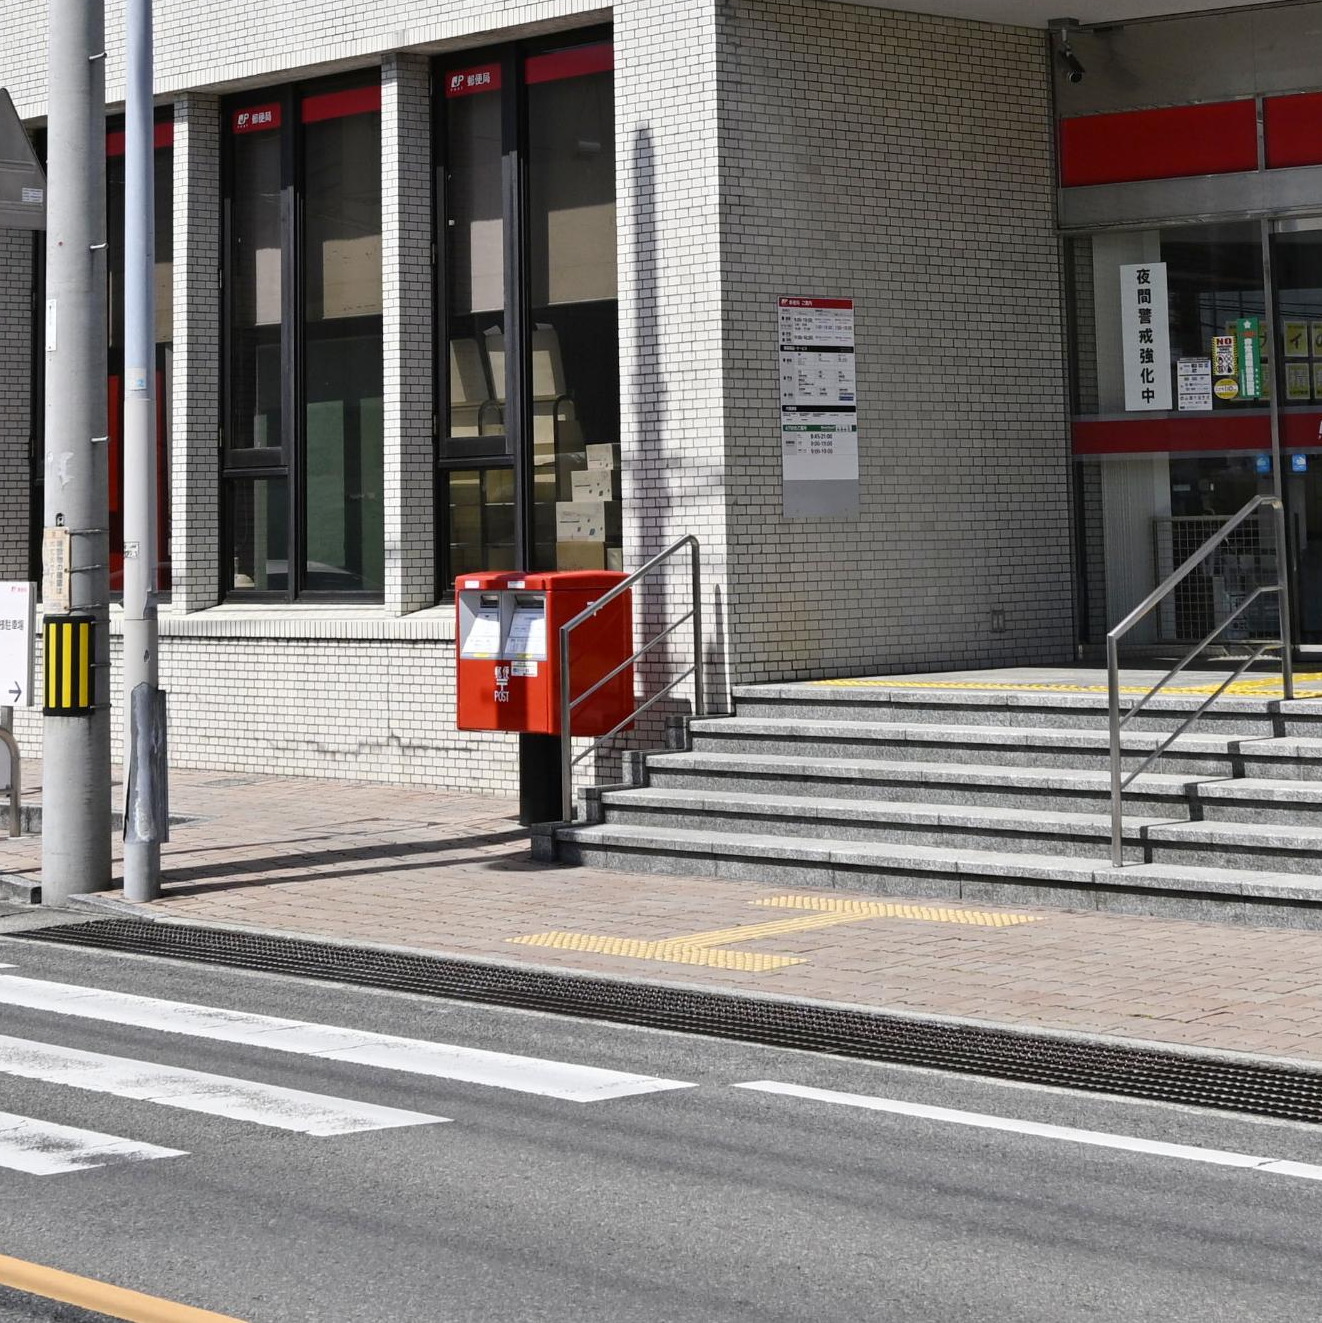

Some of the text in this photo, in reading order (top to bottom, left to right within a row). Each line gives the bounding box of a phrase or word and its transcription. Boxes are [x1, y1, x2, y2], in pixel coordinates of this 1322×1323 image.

[1136, 269, 1155, 404] 夜間警戒強化中
[494, 691, 510, 703] POST
